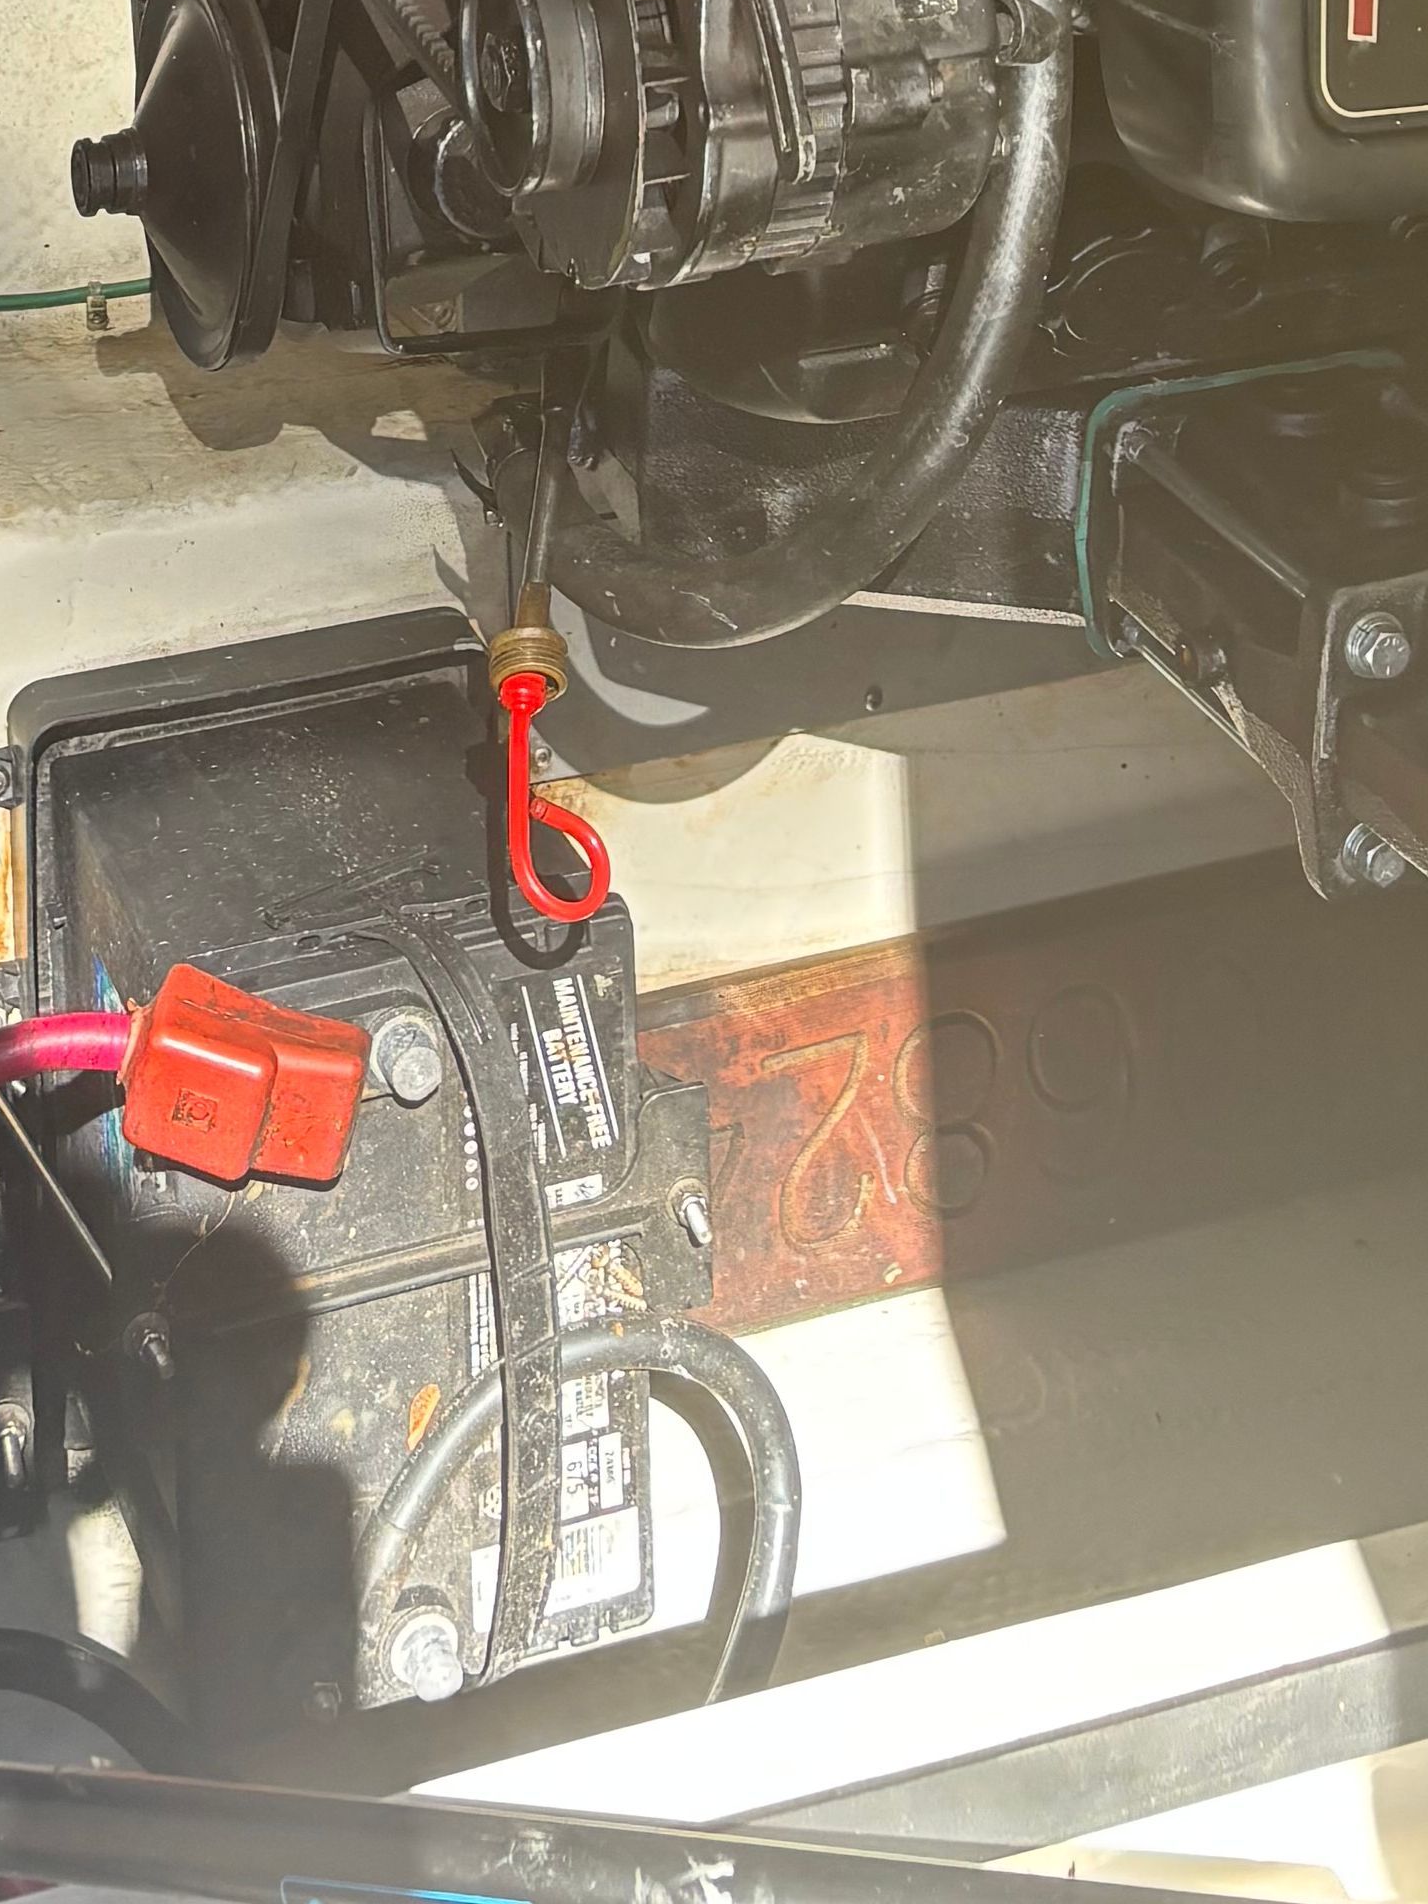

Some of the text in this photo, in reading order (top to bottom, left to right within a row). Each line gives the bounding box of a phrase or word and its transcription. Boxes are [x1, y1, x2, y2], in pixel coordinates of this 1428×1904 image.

[541, 1027, 579, 1106] BATTERY
[552, 977, 613, 1150] MAINTENANCE-FREE
[566, 1460, 584, 1495] 675
